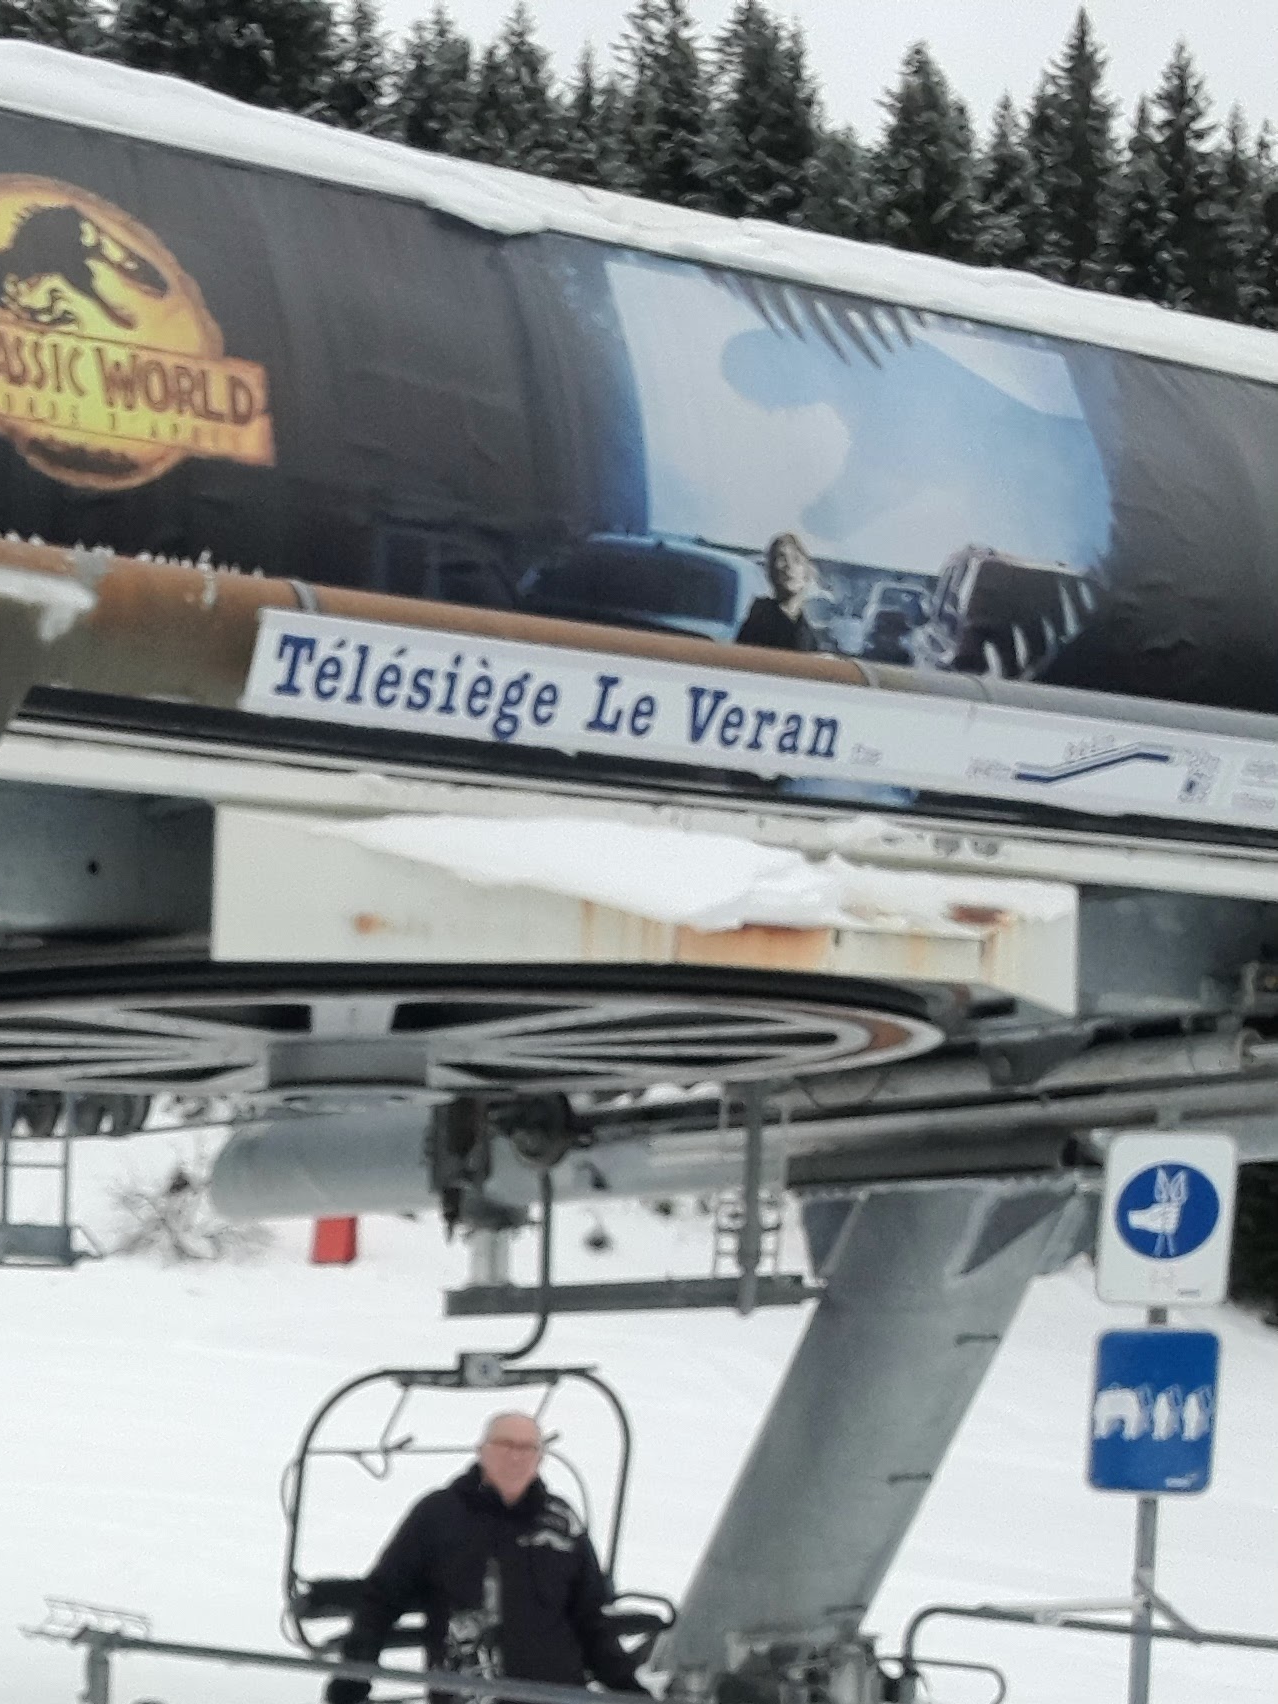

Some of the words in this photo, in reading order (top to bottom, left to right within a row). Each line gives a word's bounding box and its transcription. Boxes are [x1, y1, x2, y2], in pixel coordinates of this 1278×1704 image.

[96, 345, 254, 427] WORLD
[275, 633, 561, 741] Télésiège
[585, 674, 655, 736] Le
[687, 685, 841, 758] Veran
